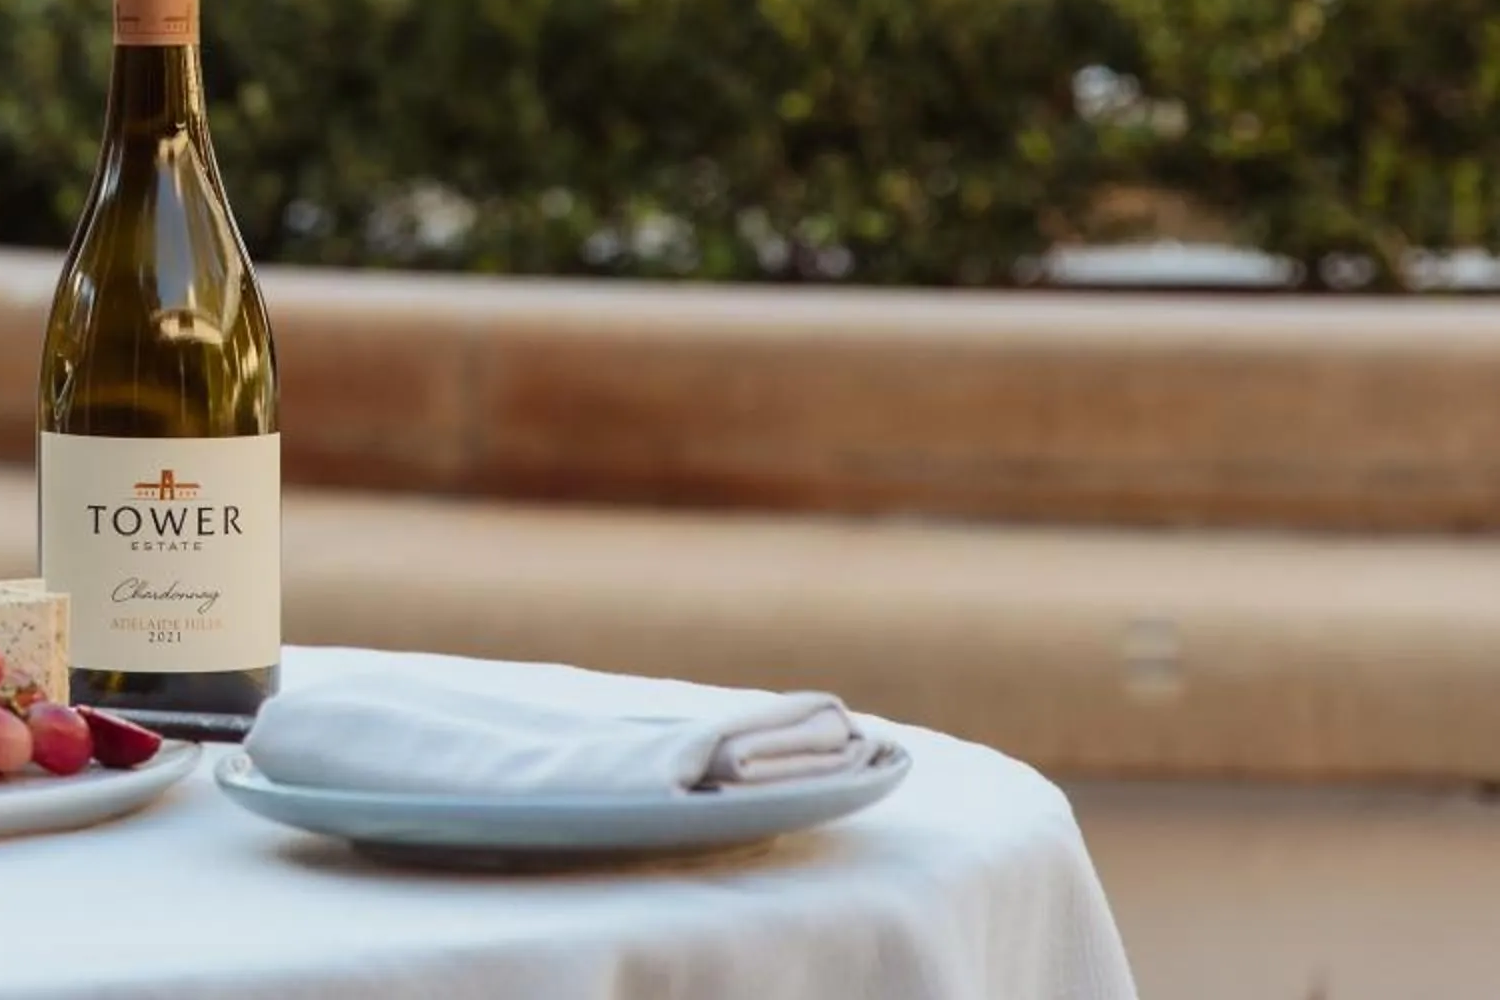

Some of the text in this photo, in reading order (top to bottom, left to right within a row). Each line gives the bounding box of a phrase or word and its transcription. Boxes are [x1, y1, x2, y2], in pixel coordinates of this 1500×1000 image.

[87, 505, 243, 536] TOWER
[131, 541, 203, 551] ESTATE
[112, 577, 220, 614] Chardonnay
[148, 631, 182, 643] 2021
